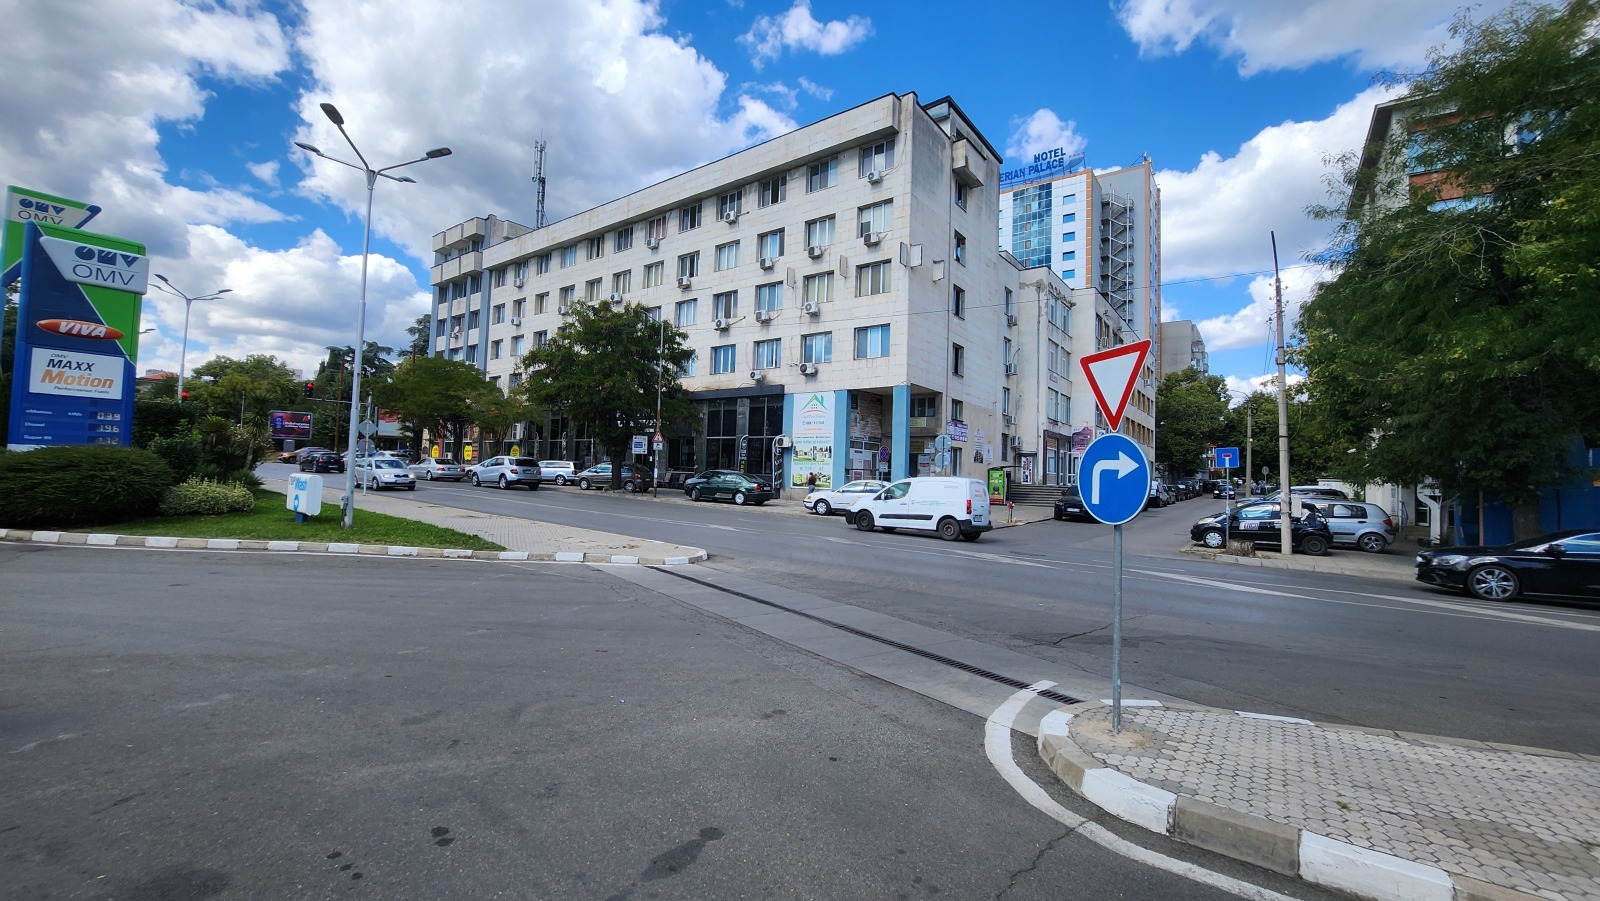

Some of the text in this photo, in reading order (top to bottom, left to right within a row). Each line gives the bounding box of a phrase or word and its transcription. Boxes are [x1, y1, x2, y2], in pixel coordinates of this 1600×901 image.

[1034, 147, 1066, 163] HOTEL
[1028, 157, 1064, 175] PALACE
[72, 264, 135, 286] OMV
[59, 321, 106, 338] VIVA
[47, 358, 95, 372] MAXX
[40, 369, 114, 389] Motion
